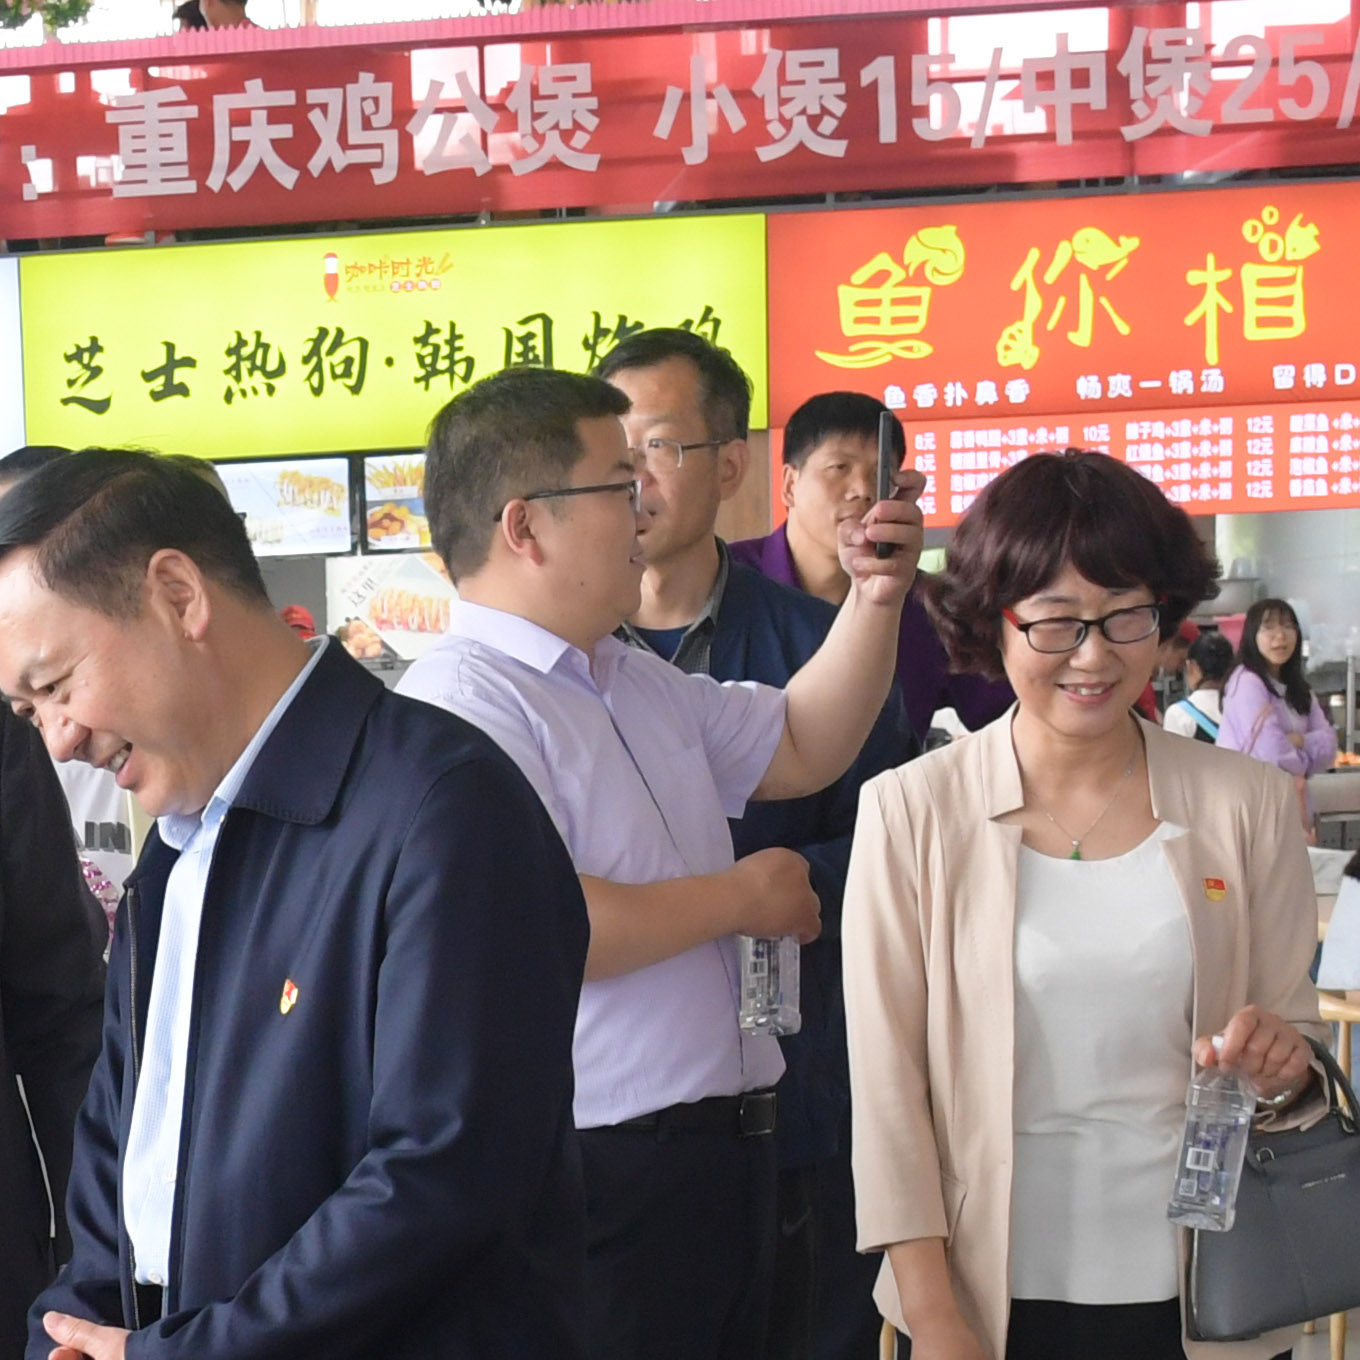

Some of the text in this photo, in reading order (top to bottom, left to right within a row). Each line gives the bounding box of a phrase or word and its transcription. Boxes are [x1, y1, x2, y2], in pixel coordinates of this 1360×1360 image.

[1082, 424, 1111, 442] 10元
[1246, 415, 1274, 434] 12元
[1246, 437, 1274, 456] 12元
[1246, 458, 1274, 477] 12元
[1246, 480, 1274, 498] 12元
